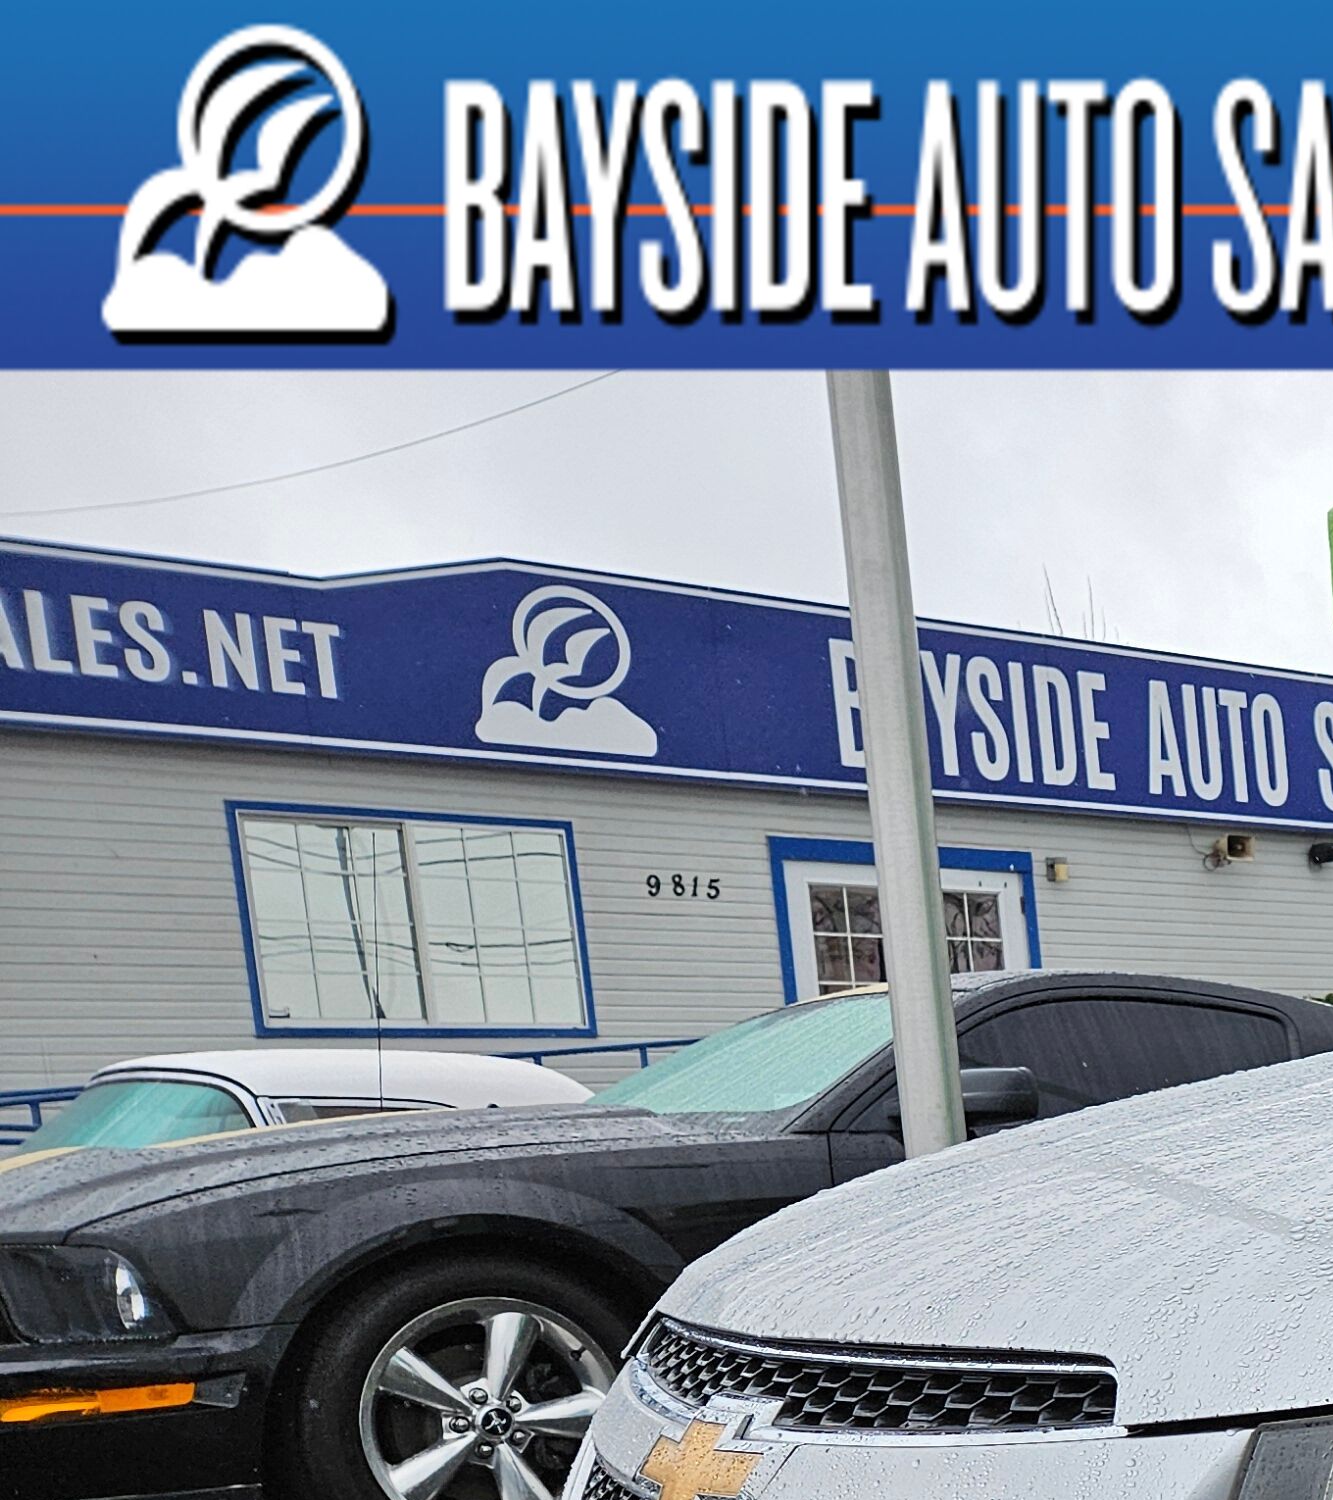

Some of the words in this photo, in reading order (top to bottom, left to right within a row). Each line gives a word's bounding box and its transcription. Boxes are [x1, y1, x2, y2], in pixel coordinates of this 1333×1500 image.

[828, 637, 1117, 793] BYSIDE
[1147, 679, 1291, 808] AUTO
[645, 873, 721, 900] 9815
